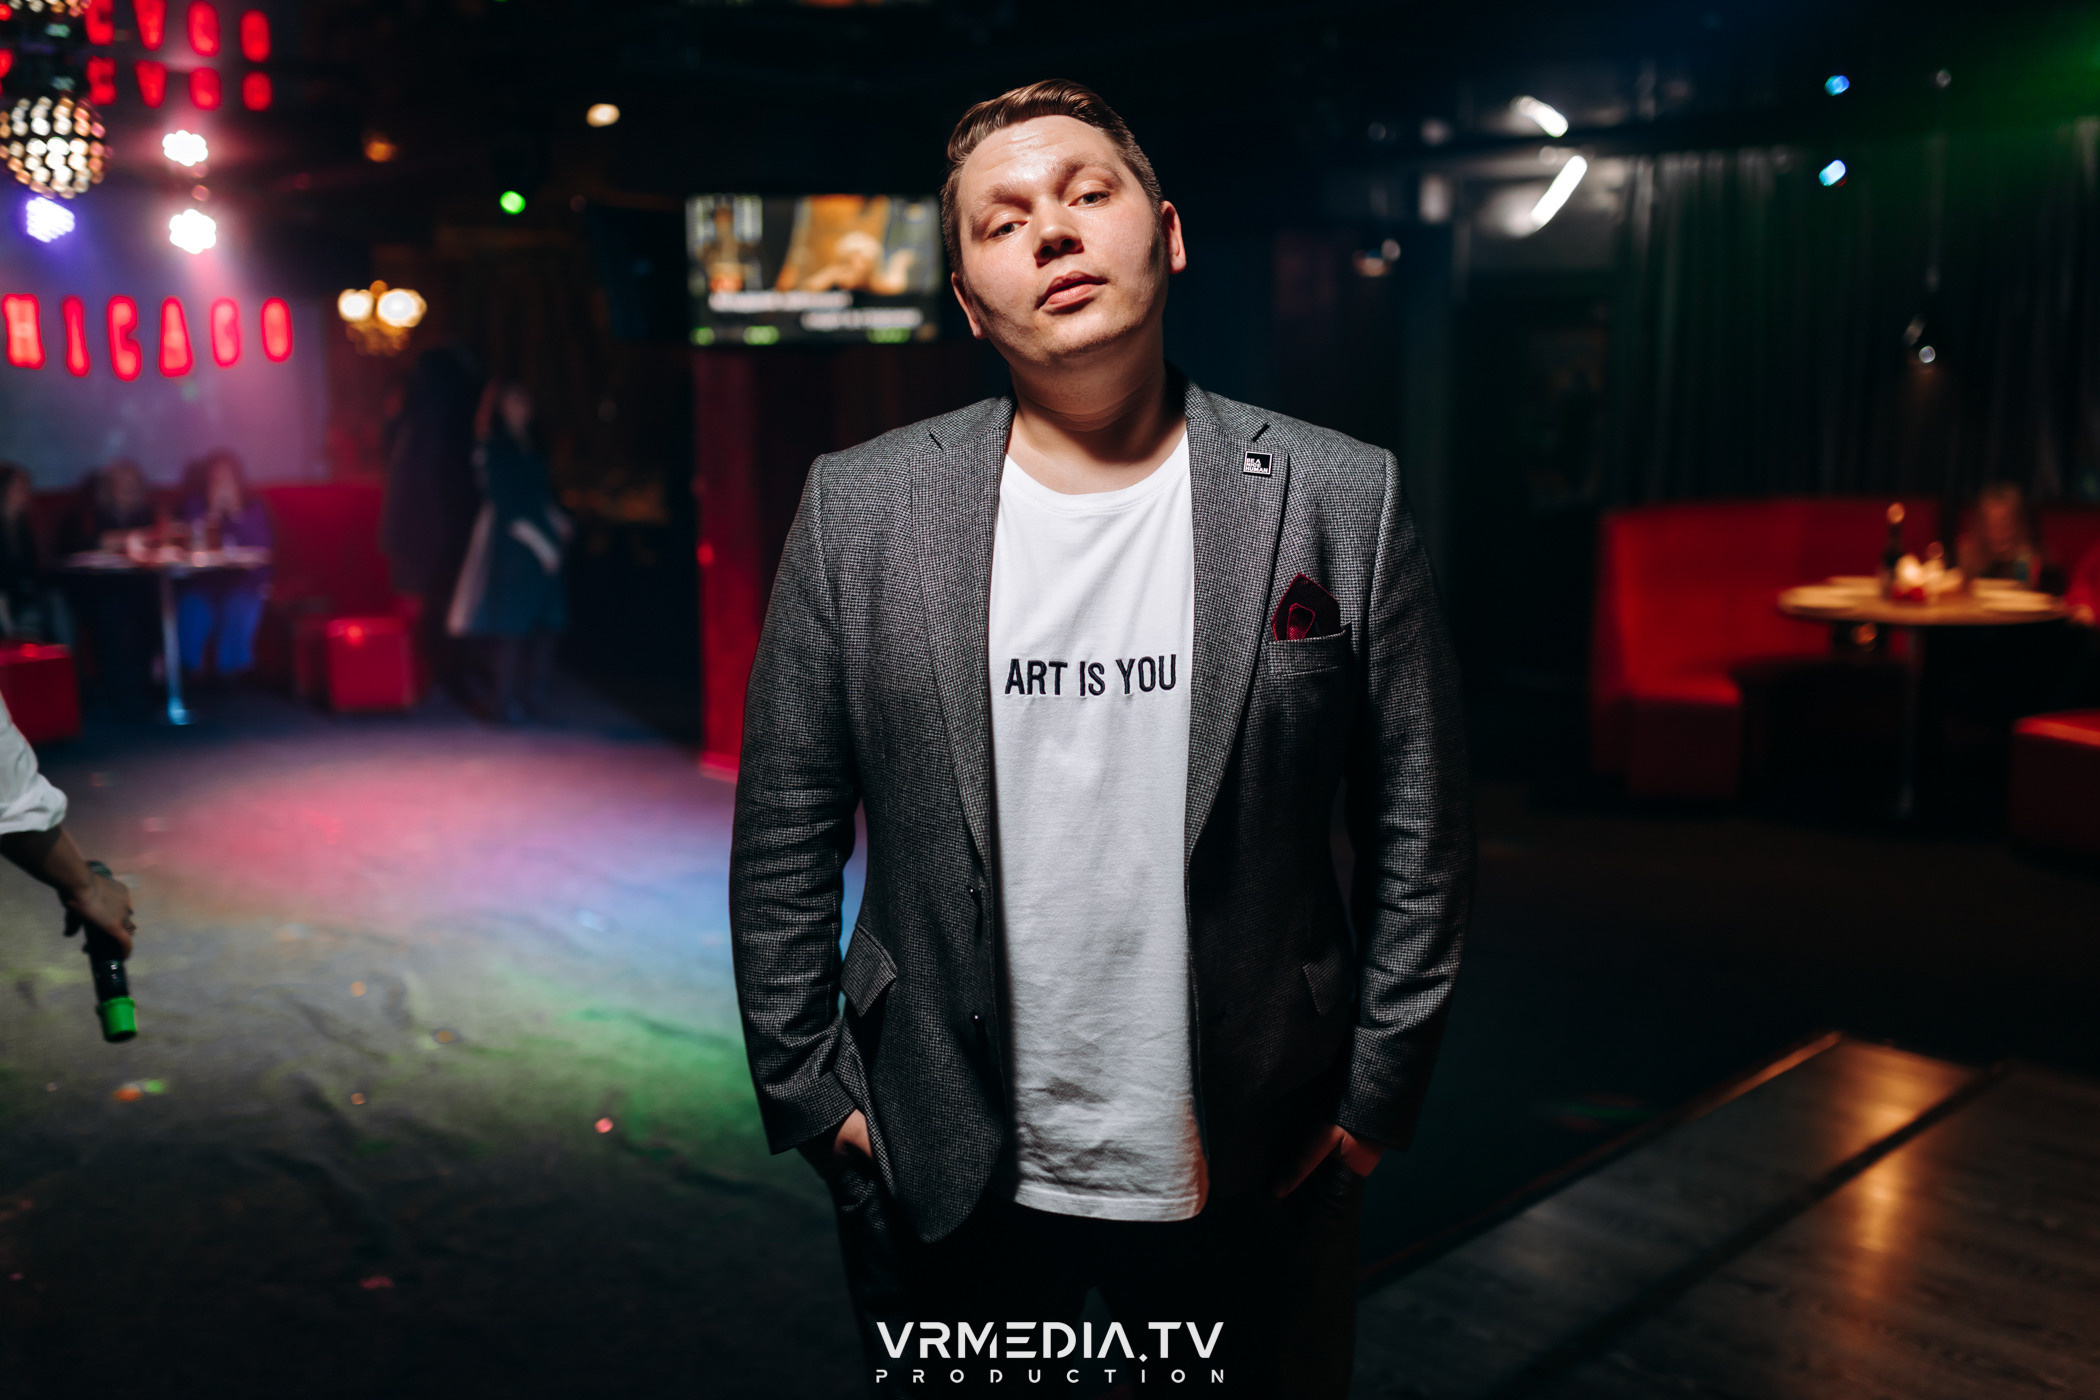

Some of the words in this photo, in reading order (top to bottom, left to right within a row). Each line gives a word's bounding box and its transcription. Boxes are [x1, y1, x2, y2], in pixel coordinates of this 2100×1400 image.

[1005, 658, 1068, 696] ART
[1079, 661, 1106, 697] IS
[1115, 654, 1177, 695] YOU
